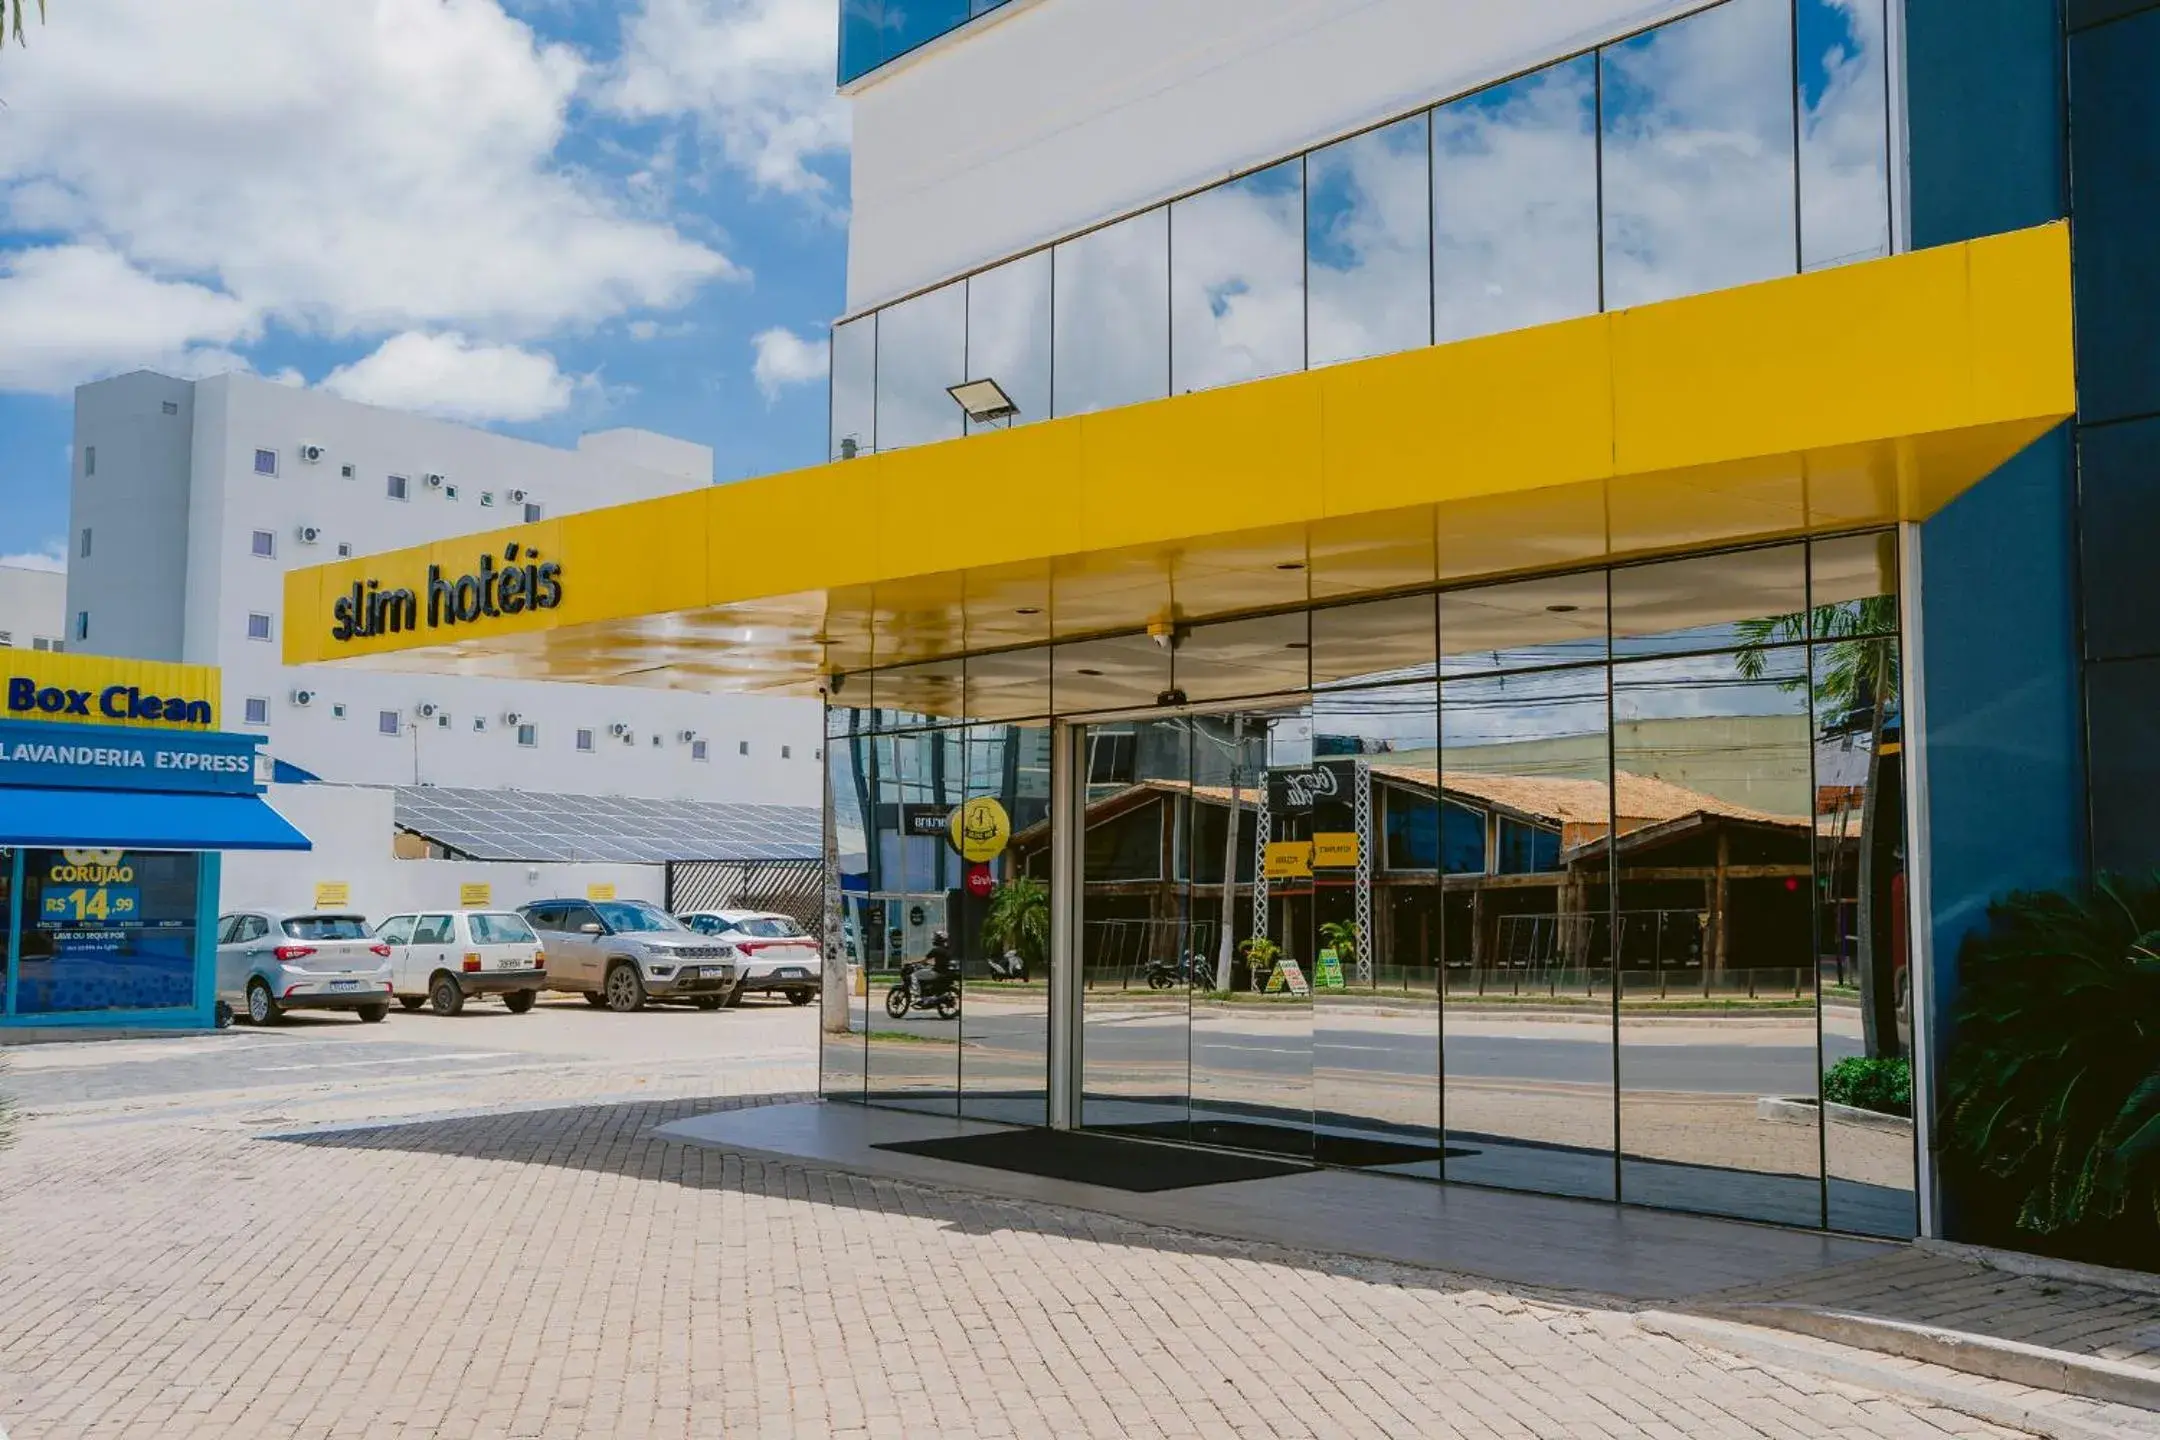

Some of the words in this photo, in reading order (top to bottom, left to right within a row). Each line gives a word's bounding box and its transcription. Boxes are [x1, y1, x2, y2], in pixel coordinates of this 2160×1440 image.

[332, 577, 417, 641] slim
[427, 542, 562, 628] hotéis
[8, 677, 92, 717] Box
[100, 686, 212, 724] Clean
[0, 742, 146, 768] LAVANDERIA
[155, 751, 250, 773] EXPRESS
